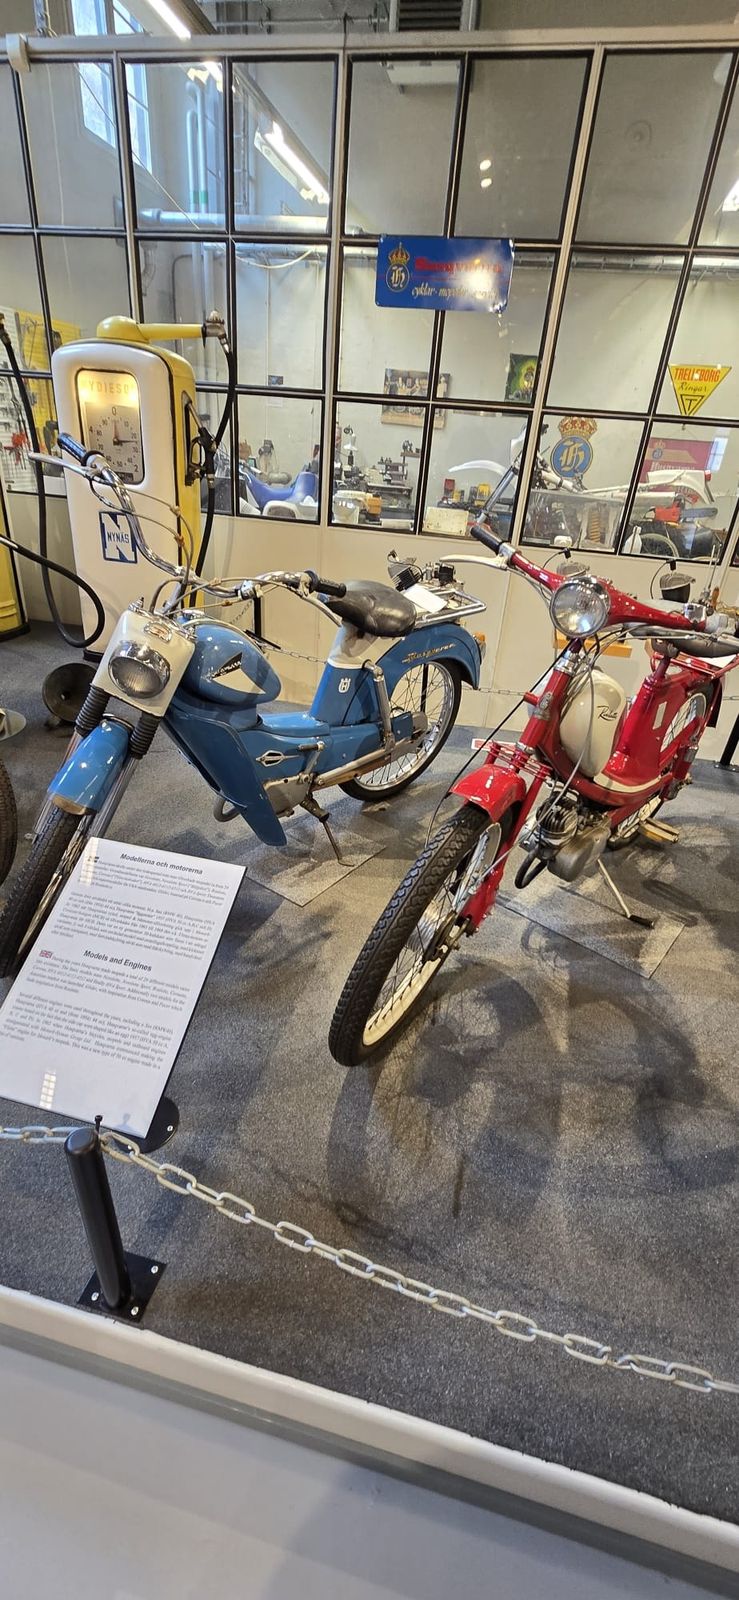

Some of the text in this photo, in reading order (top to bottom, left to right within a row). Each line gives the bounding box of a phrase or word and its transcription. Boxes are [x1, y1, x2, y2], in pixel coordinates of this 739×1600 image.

[120, 853, 203, 875] Modellerna och motorerna
[83, 949, 152, 973] Models and Engines
